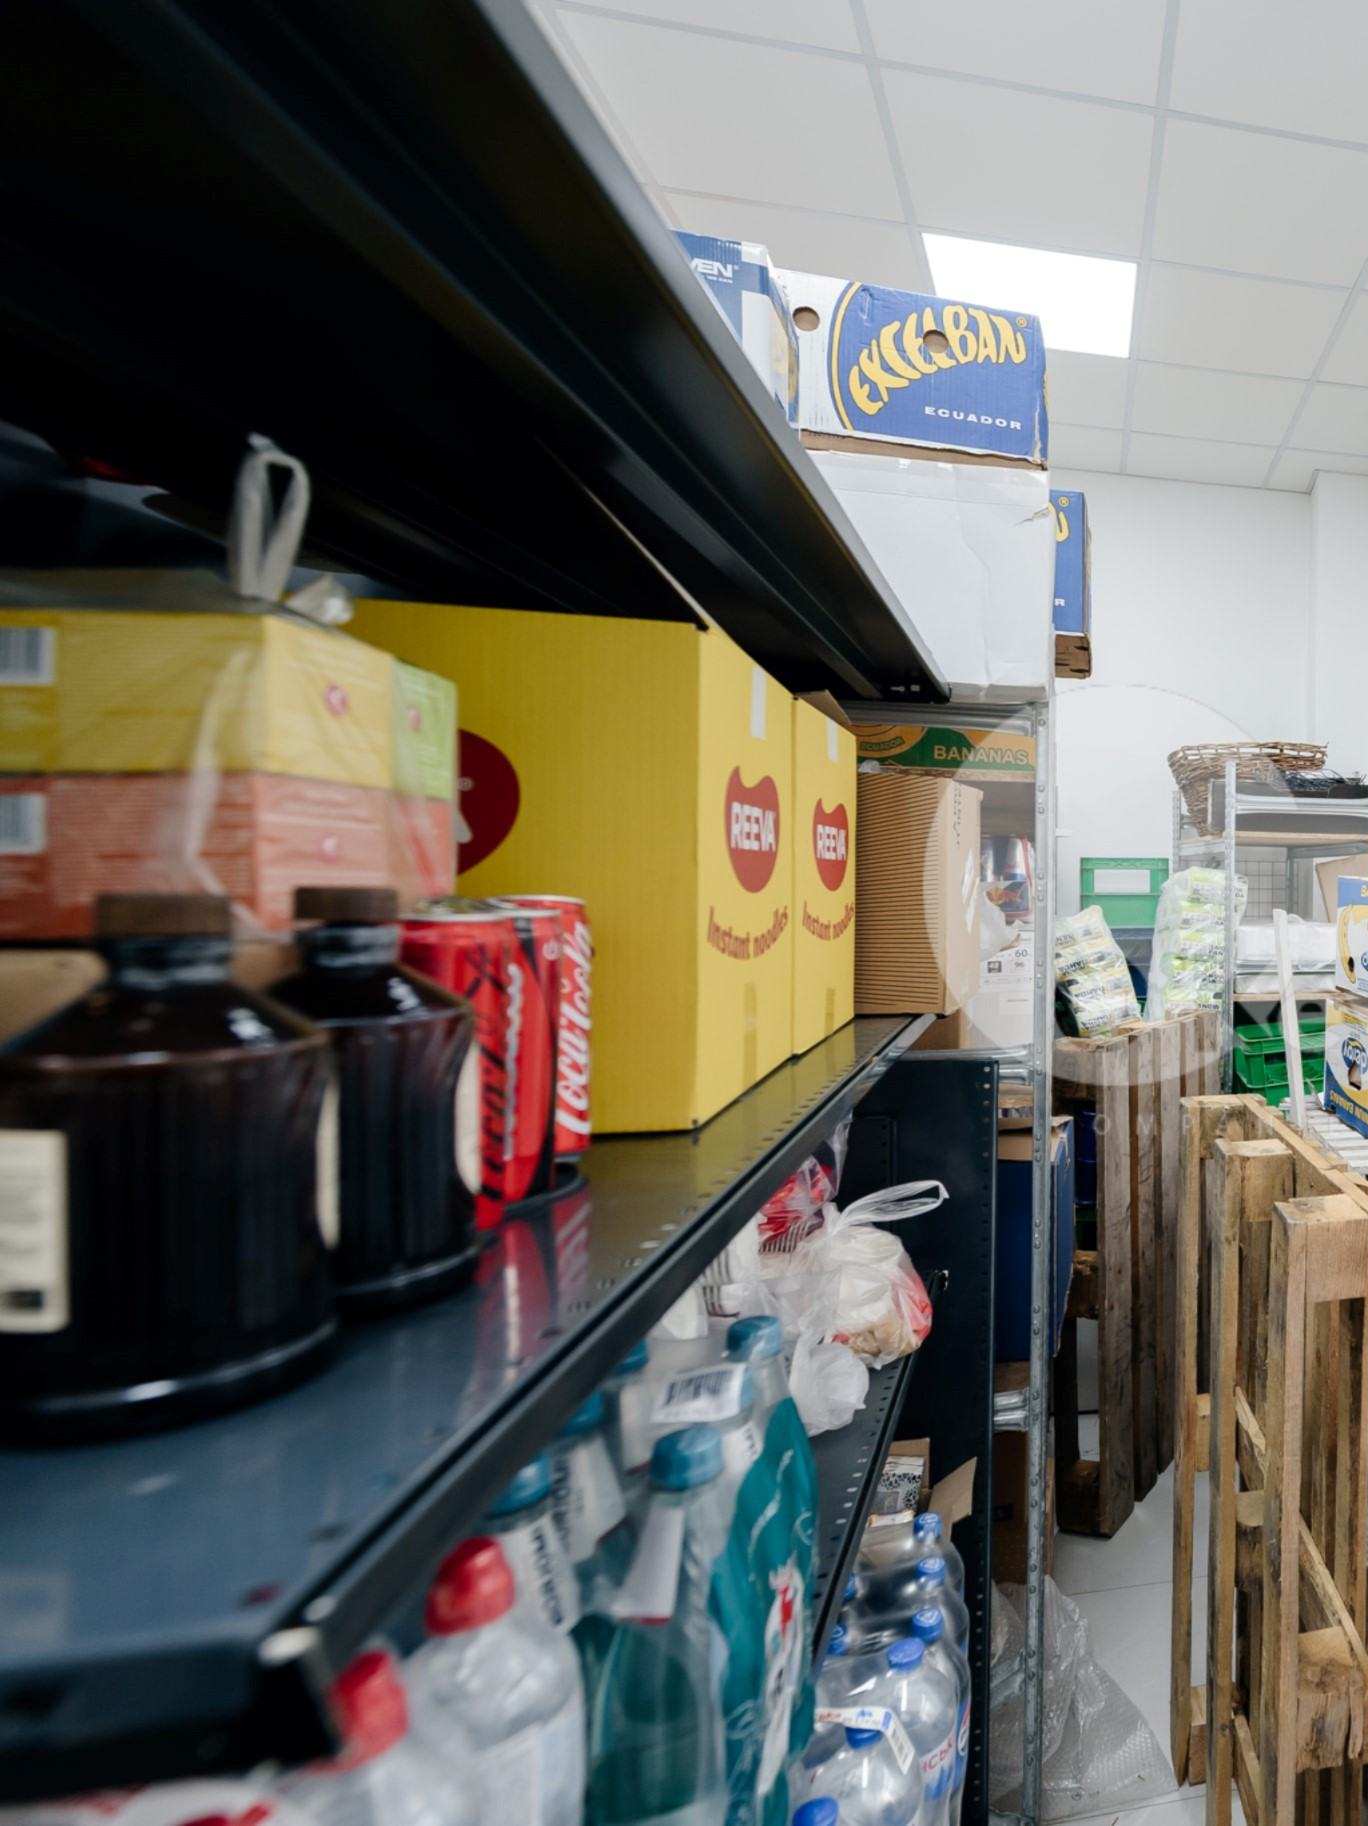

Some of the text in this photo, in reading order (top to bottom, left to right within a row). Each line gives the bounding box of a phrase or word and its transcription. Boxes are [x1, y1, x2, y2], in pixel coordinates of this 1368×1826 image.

[924, 405, 1022, 430] ECUADOR
[860, 736, 904, 751] ECUADOR
[933, 744, 1029, 765] BANANAS
[730, 801, 777, 852] REEVA
[816, 823, 847, 861] REEVA
[707, 905, 788, 960] Instant noodles
[802, 900, 831, 941] Instant
[1014, 948, 1028, 958] 60
